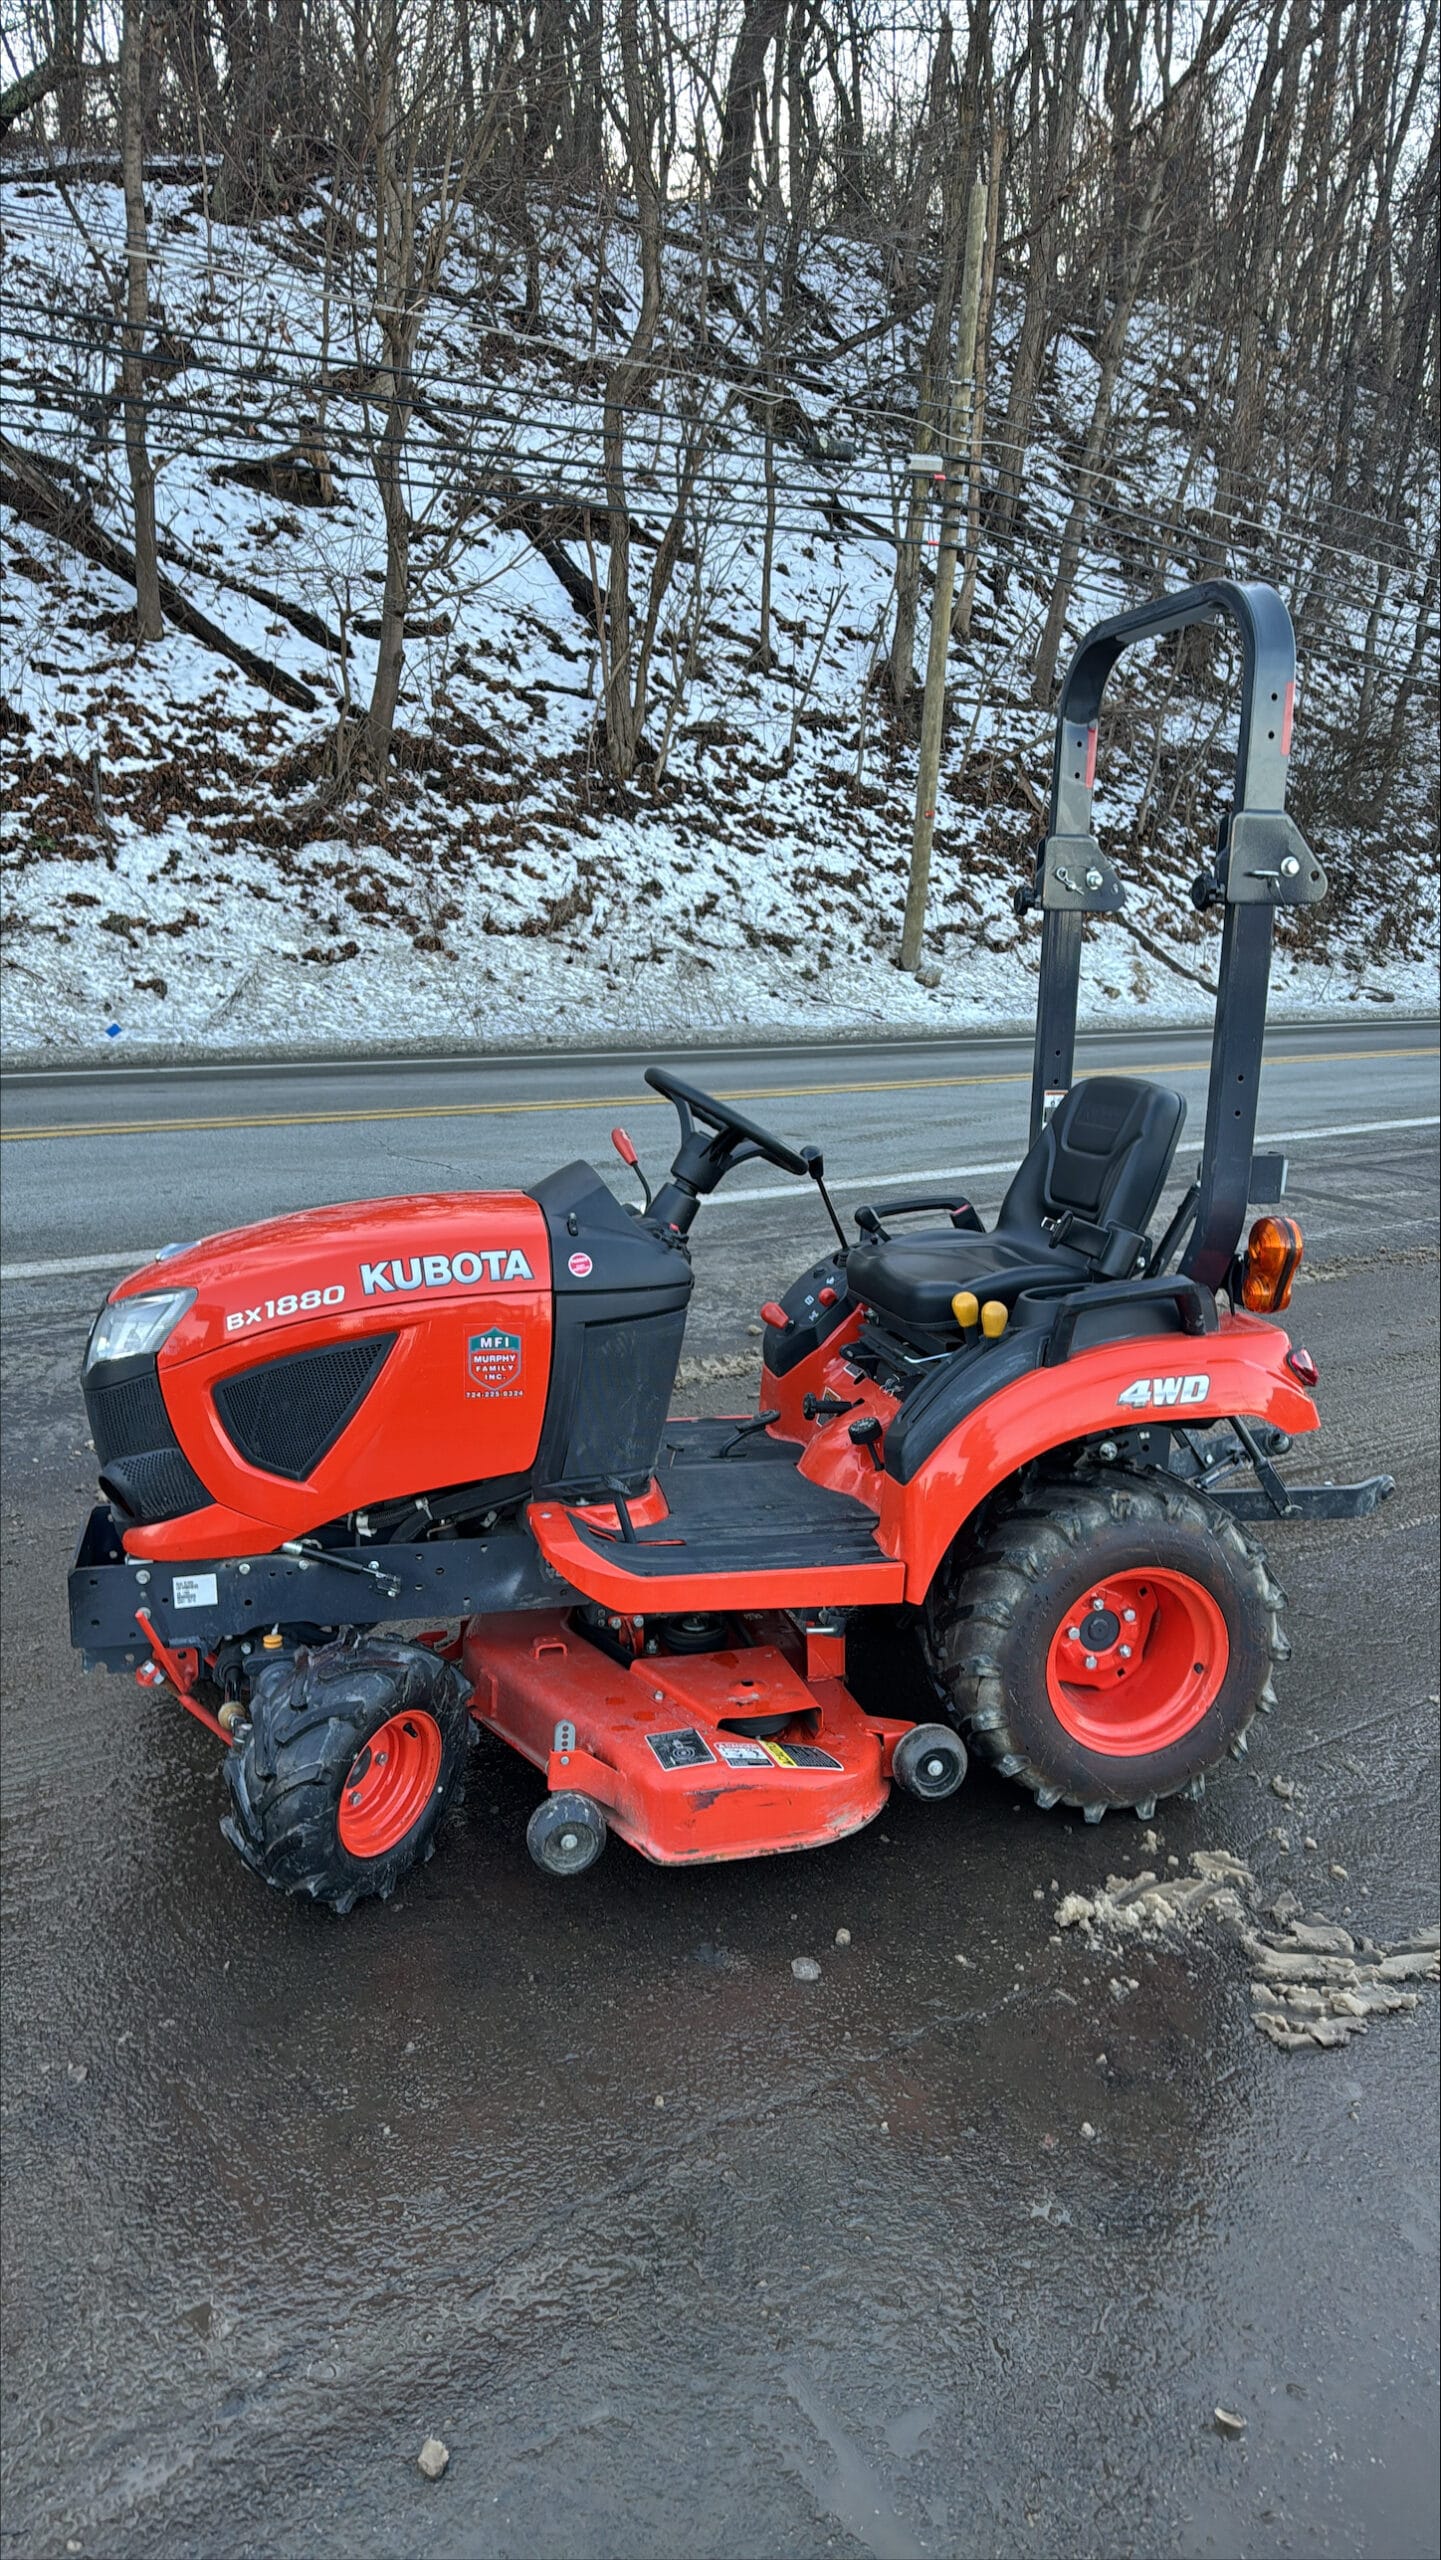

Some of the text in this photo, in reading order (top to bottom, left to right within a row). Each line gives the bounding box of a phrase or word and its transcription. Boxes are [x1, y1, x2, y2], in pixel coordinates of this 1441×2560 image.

[359, 1249, 535, 1295] KUBOTA
[226, 1285, 346, 1332] BX1880
[473, 1355, 516, 1363] MURPHY
[480, 1337, 509, 1348] MFI
[1117, 1374, 1211, 1408] 4WD
